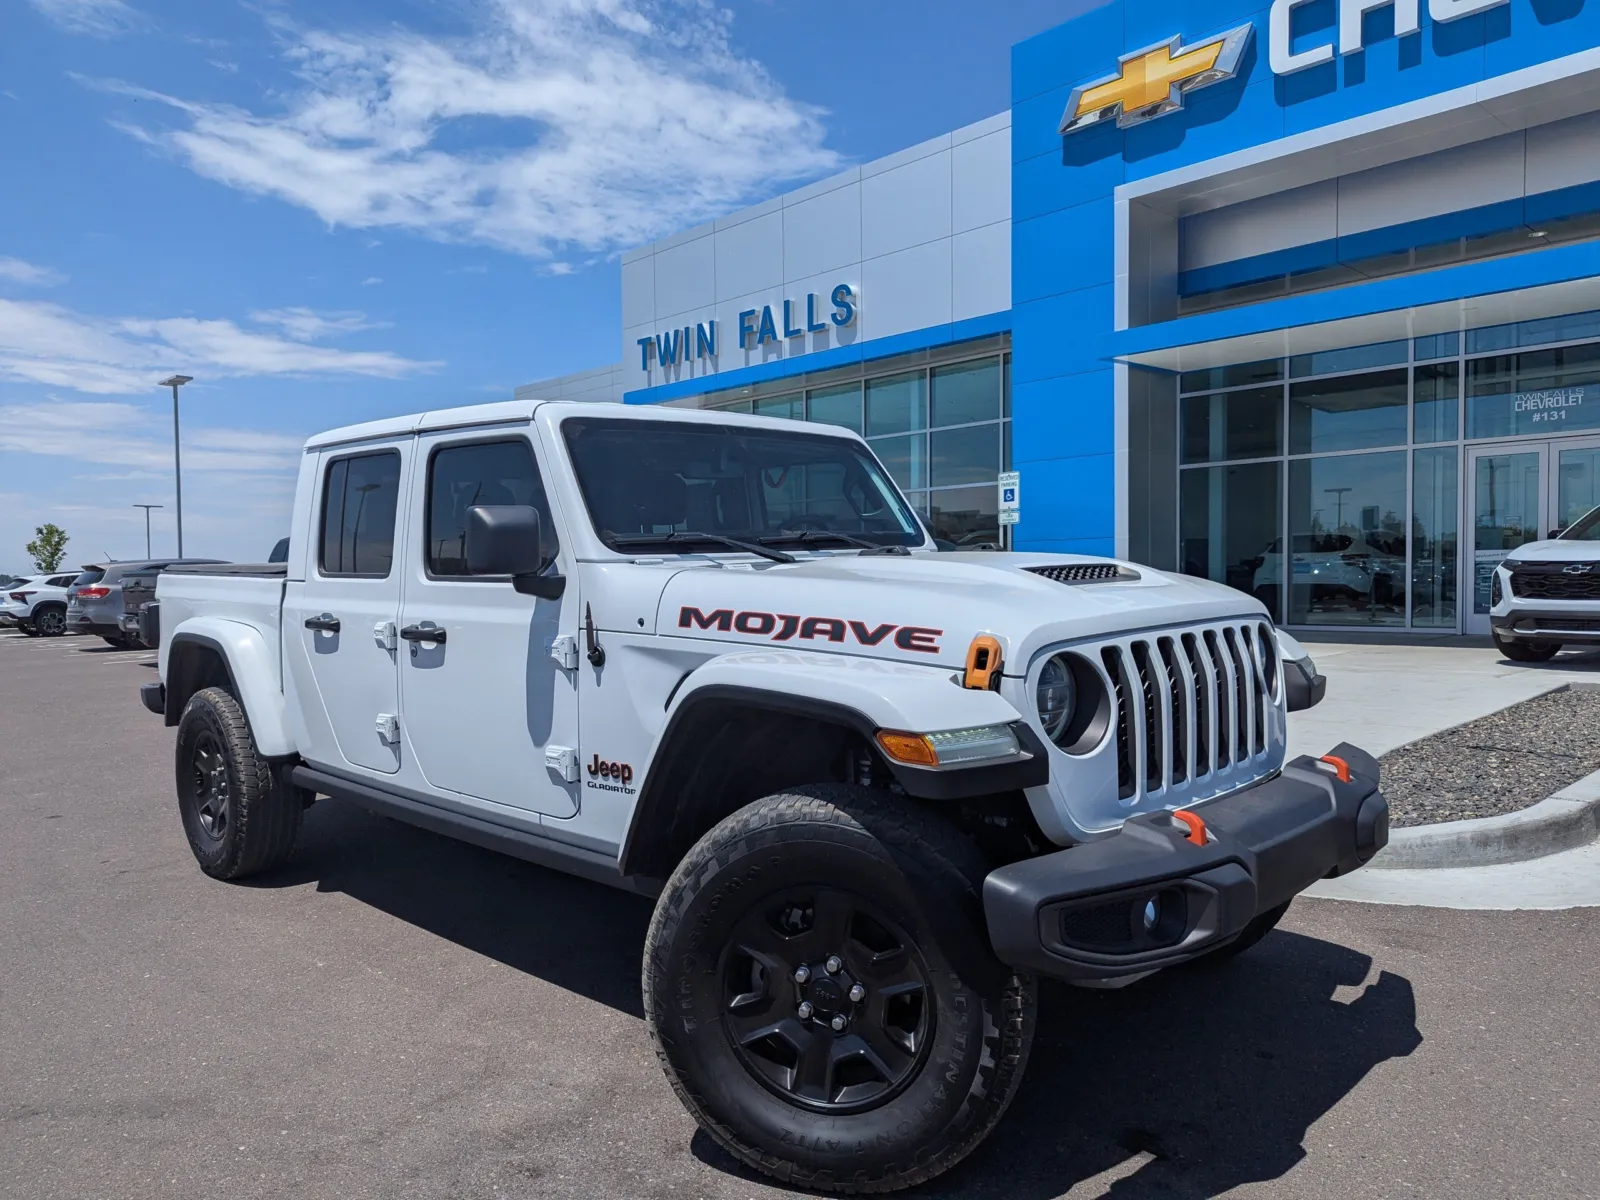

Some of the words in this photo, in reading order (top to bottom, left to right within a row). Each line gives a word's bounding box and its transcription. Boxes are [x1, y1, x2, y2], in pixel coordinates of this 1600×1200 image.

[1269, 0, 1511, 76] CH
[637, 320, 718, 372] TWIN
[739, 284, 857, 350] FALLS
[1515, 394, 1584, 412] CHEVROLET
[1532, 410, 1566, 423] #131
[678, 606, 944, 654] MOJAVE
[587, 753, 634, 785] Jeep
[587, 781, 637, 796] GLADIATOR
